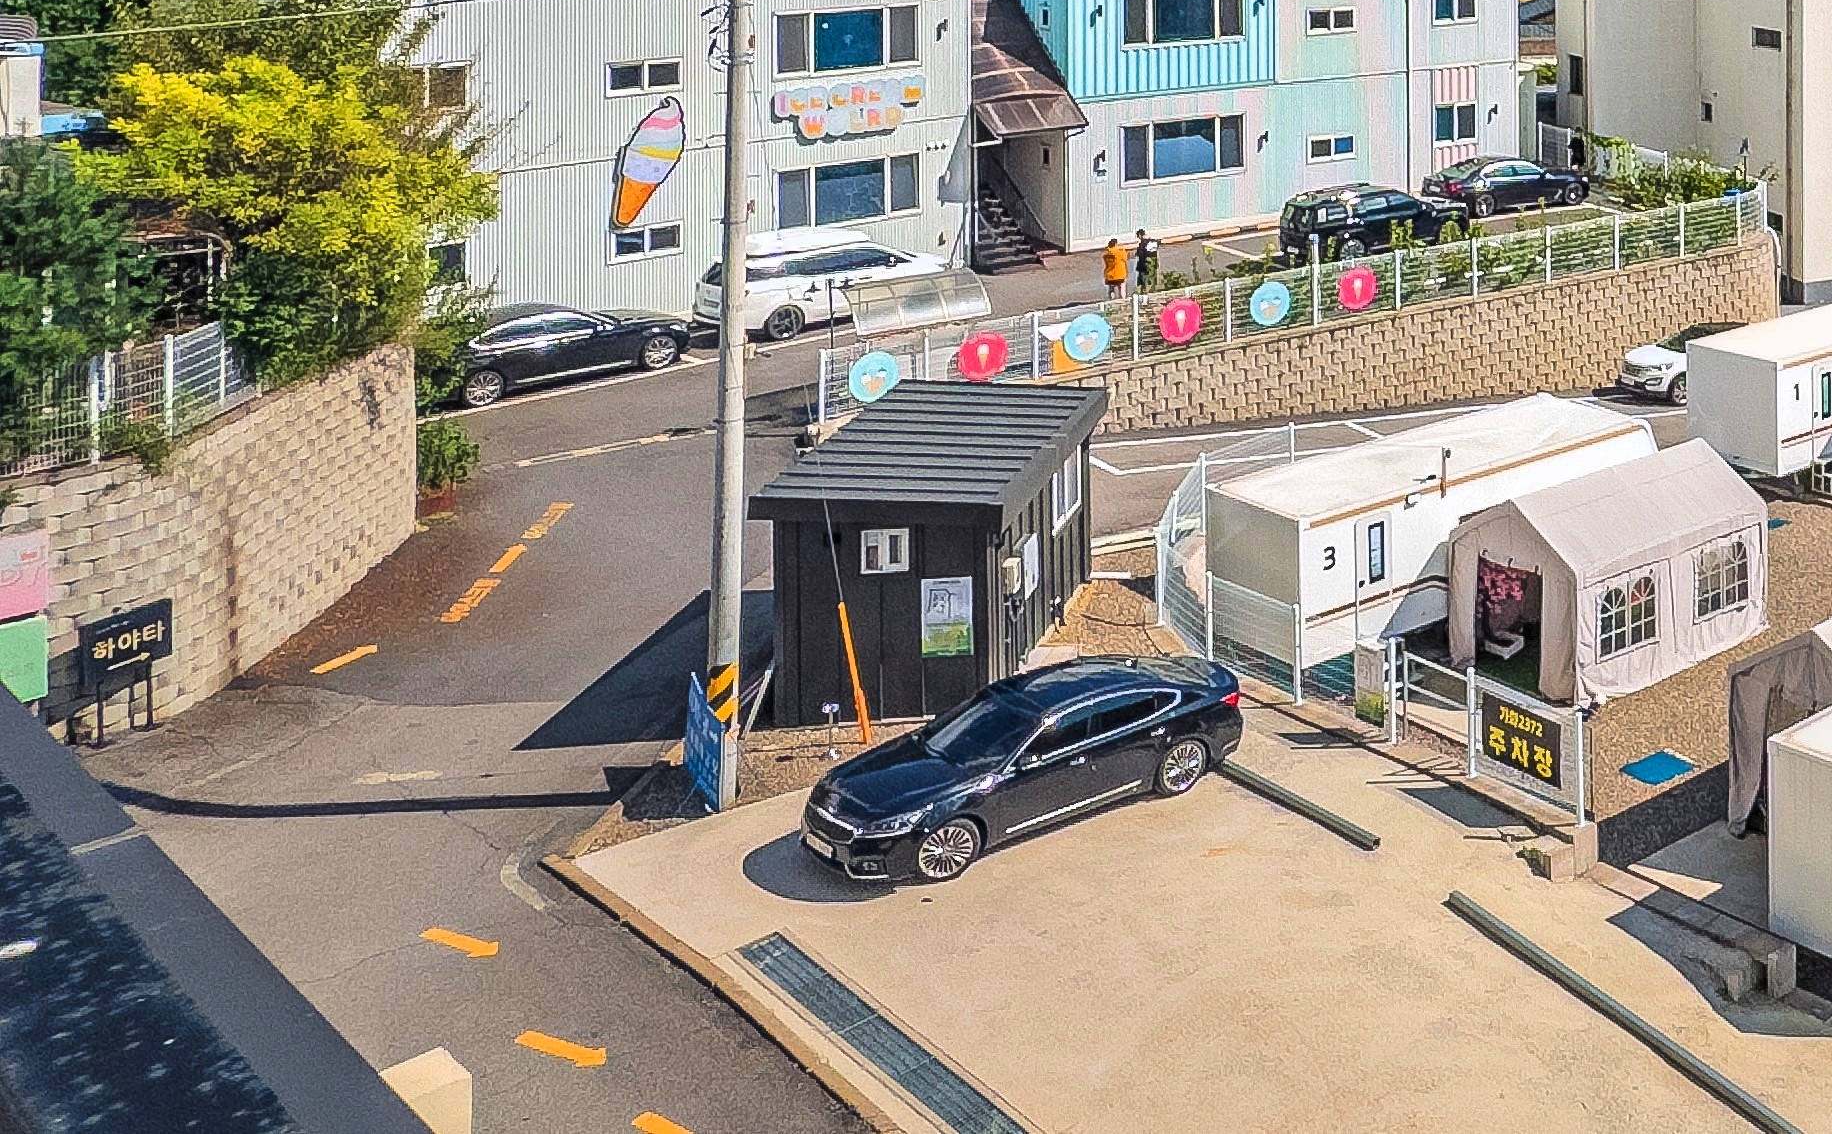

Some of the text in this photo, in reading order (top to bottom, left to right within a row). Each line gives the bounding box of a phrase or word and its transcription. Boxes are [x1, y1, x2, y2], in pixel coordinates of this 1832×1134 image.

[1794, 383, 1800, 401] 1
[1323, 545, 1336, 571] 3
[92, 620, 166, 659] 하야타
[1489, 725, 1553, 778] 주차장
